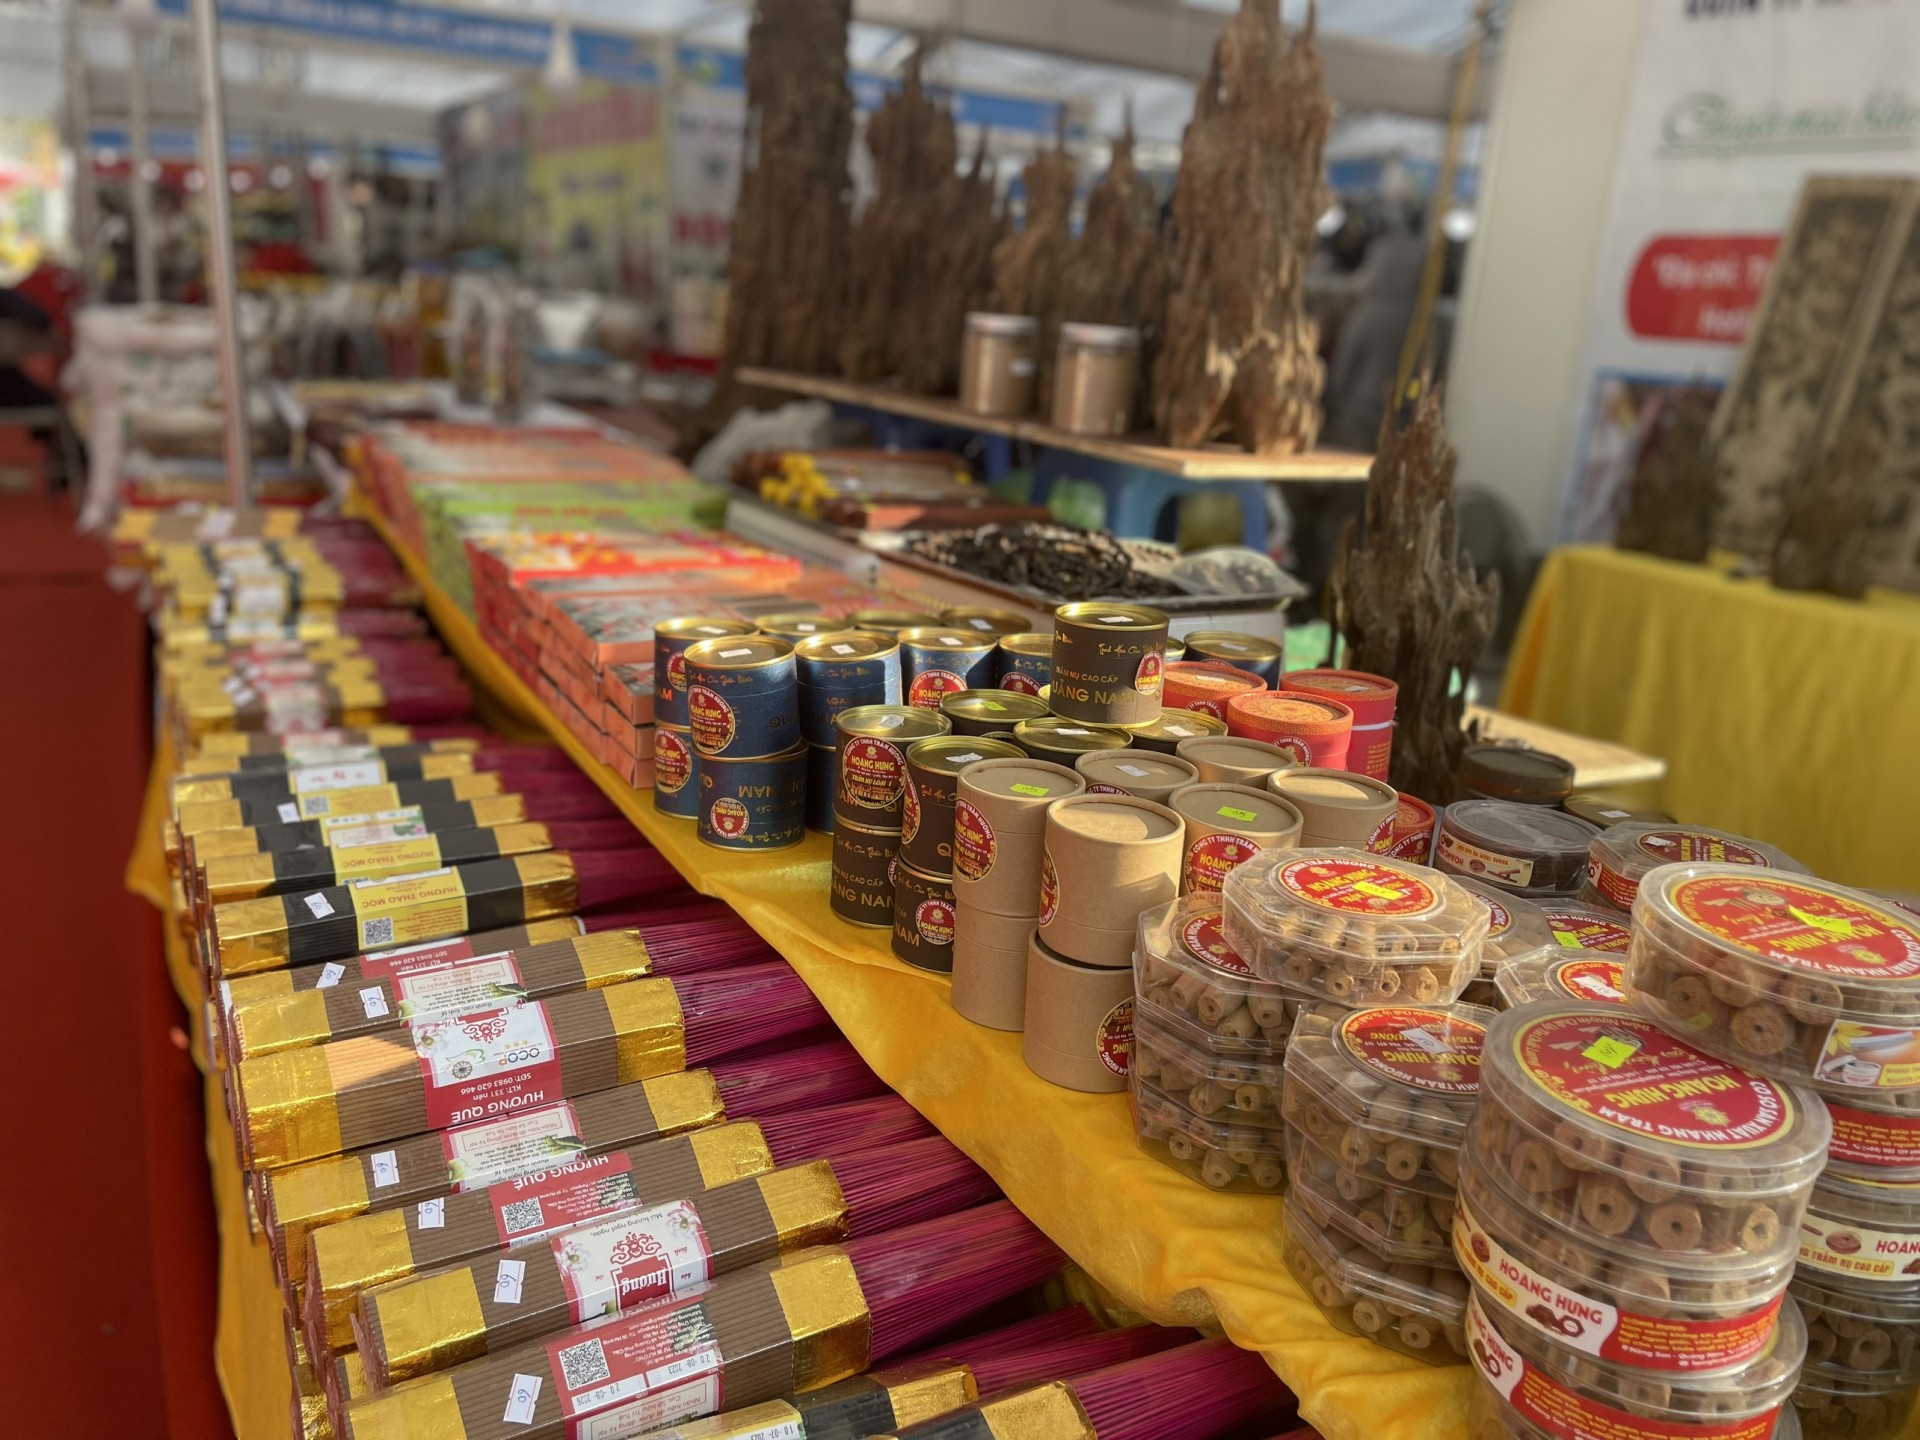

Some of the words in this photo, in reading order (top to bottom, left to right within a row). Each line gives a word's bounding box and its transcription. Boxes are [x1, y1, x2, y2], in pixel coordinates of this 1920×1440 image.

[1069, 671, 1080, 683] NỤ
[1081, 673, 1099, 683] CAO
[1101, 675, 1119, 684] CẤP
[1052, 678, 1089, 701] UẢNG
[1094, 690, 1135, 704] NAM
[1217, 836, 1235, 844] TNHH
[850, 874, 865, 885] CAO
[419, 886, 457, 898] HƯƠNG
[362, 898, 386, 908] MỘC
[388, 893, 416, 903] THẢO
[498, 1047, 539, 1066] OCOP
[494, 1077, 513, 1087] 0983
[514, 1072, 532, 1082] SĐT:
[460, 1086, 476, 1095] 466
[477, 1082, 492, 1091] 620
[505, 1084, 521, 1093] KLT:
[473, 1092, 488, 1101] nén
[490, 1088, 504, 1098] 331
[487, 1090, 544, 1112] HƯƠNG
[1657, 1124, 1726, 1141] NHANG
[627, 1215, 649, 1227] hương
[650, 1212, 663, 1222] Mùi
[611, 1222, 627, 1232] ngọt
[1854, 1261, 1872, 1272] CAO
[621, 1266, 667, 1296] Hương
[667, 1362, 683, 1375] 2023
[666, 1393, 681, 1404] Cục
[681, 1395, 701, 1407] Nhãn
[655, 1408, 665, 1417] đã
[665, 1401, 681, 1413] hiệu
[637, 1411, 656, 1424] được
[607, 1424, 618, 1434] ký
[617, 1417, 637, 1431] đăng
